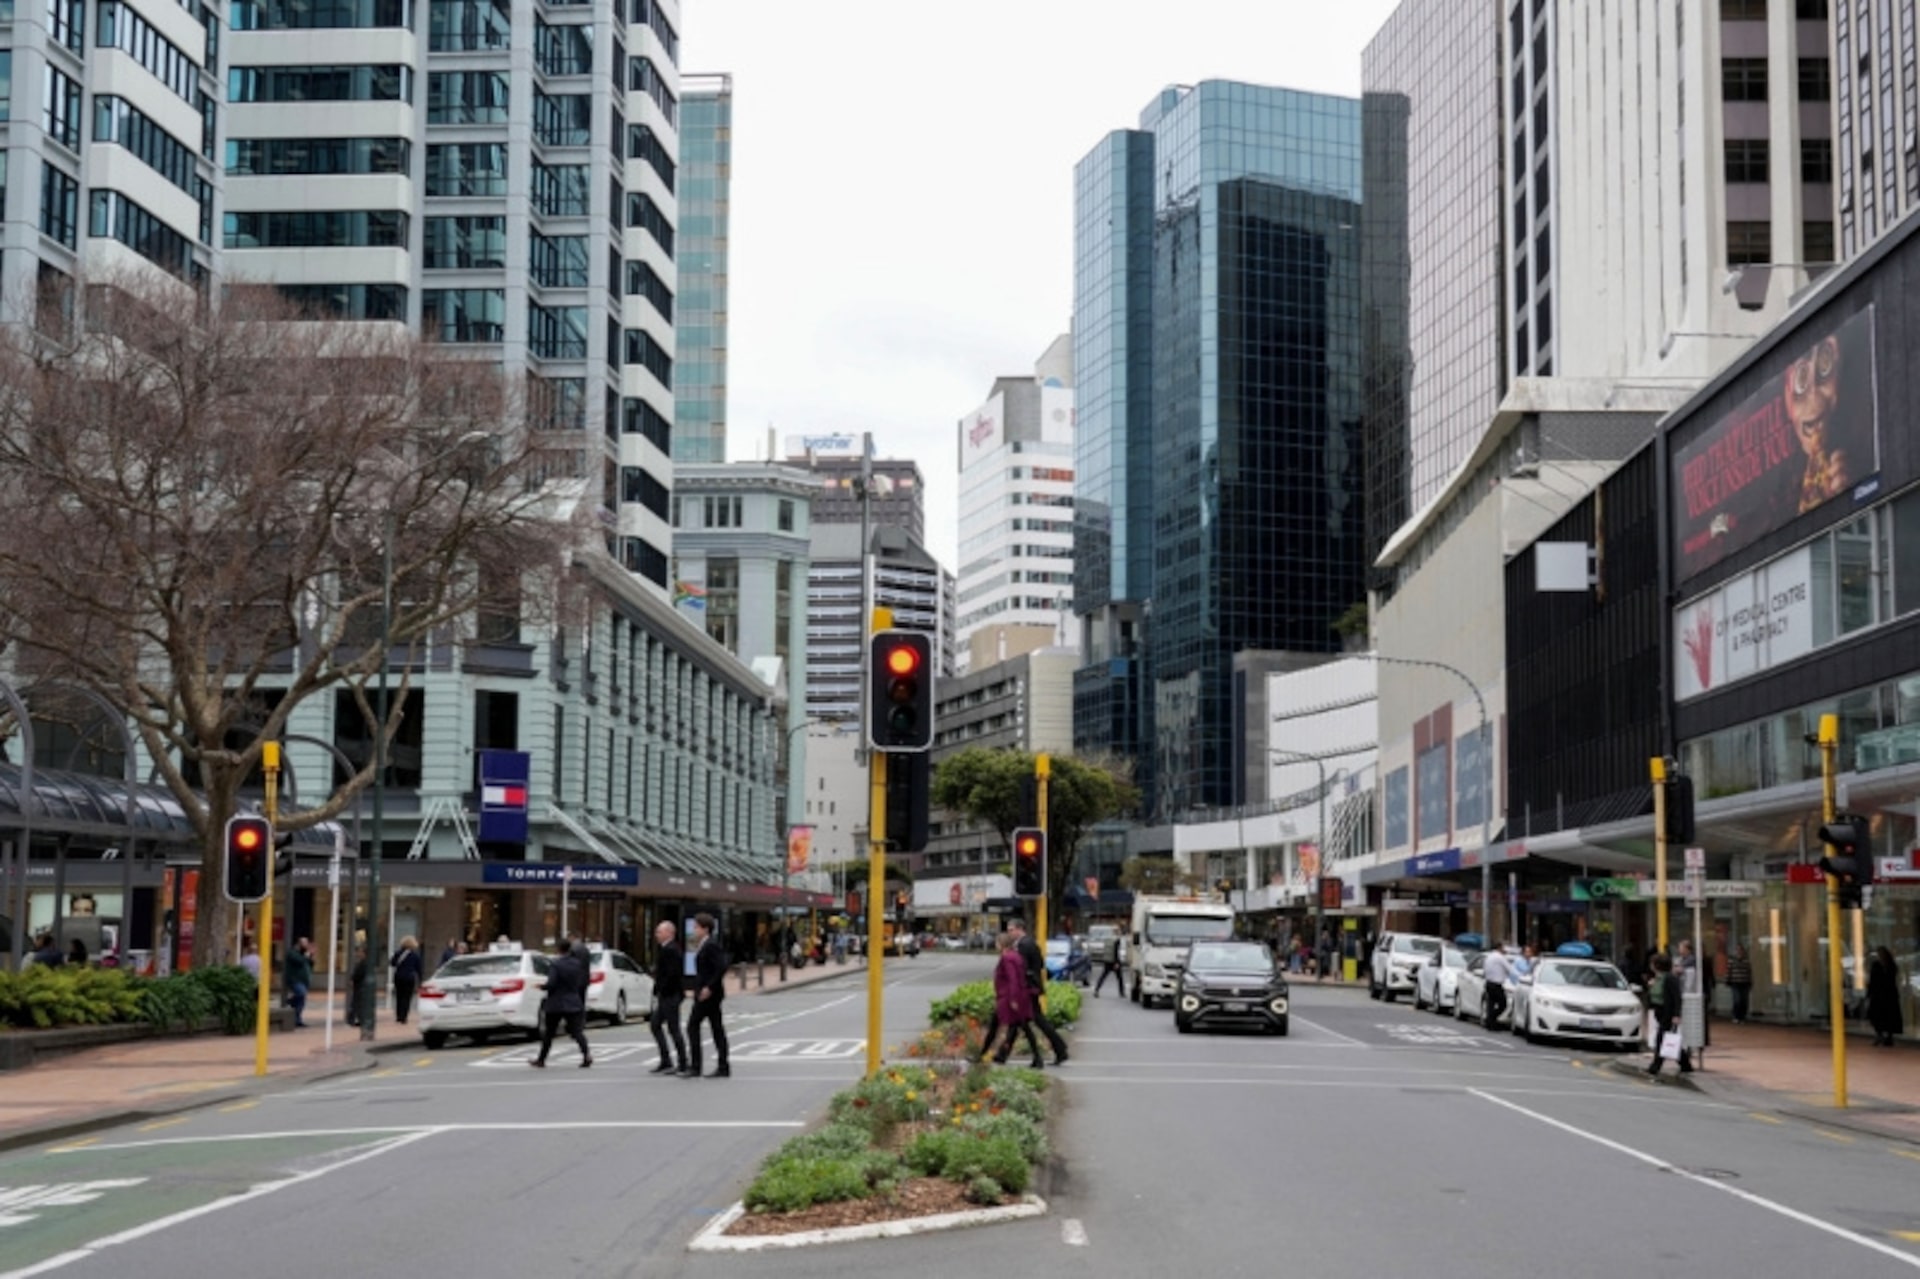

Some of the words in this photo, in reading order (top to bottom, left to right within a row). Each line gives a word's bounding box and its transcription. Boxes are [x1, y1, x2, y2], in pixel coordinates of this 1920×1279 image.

[802, 436, 852, 449] brother
[1771, 582, 1806, 612] CENTRE
[1740, 617, 1788, 648] PHARMACY
[506, 867, 556, 880] TOMMY
